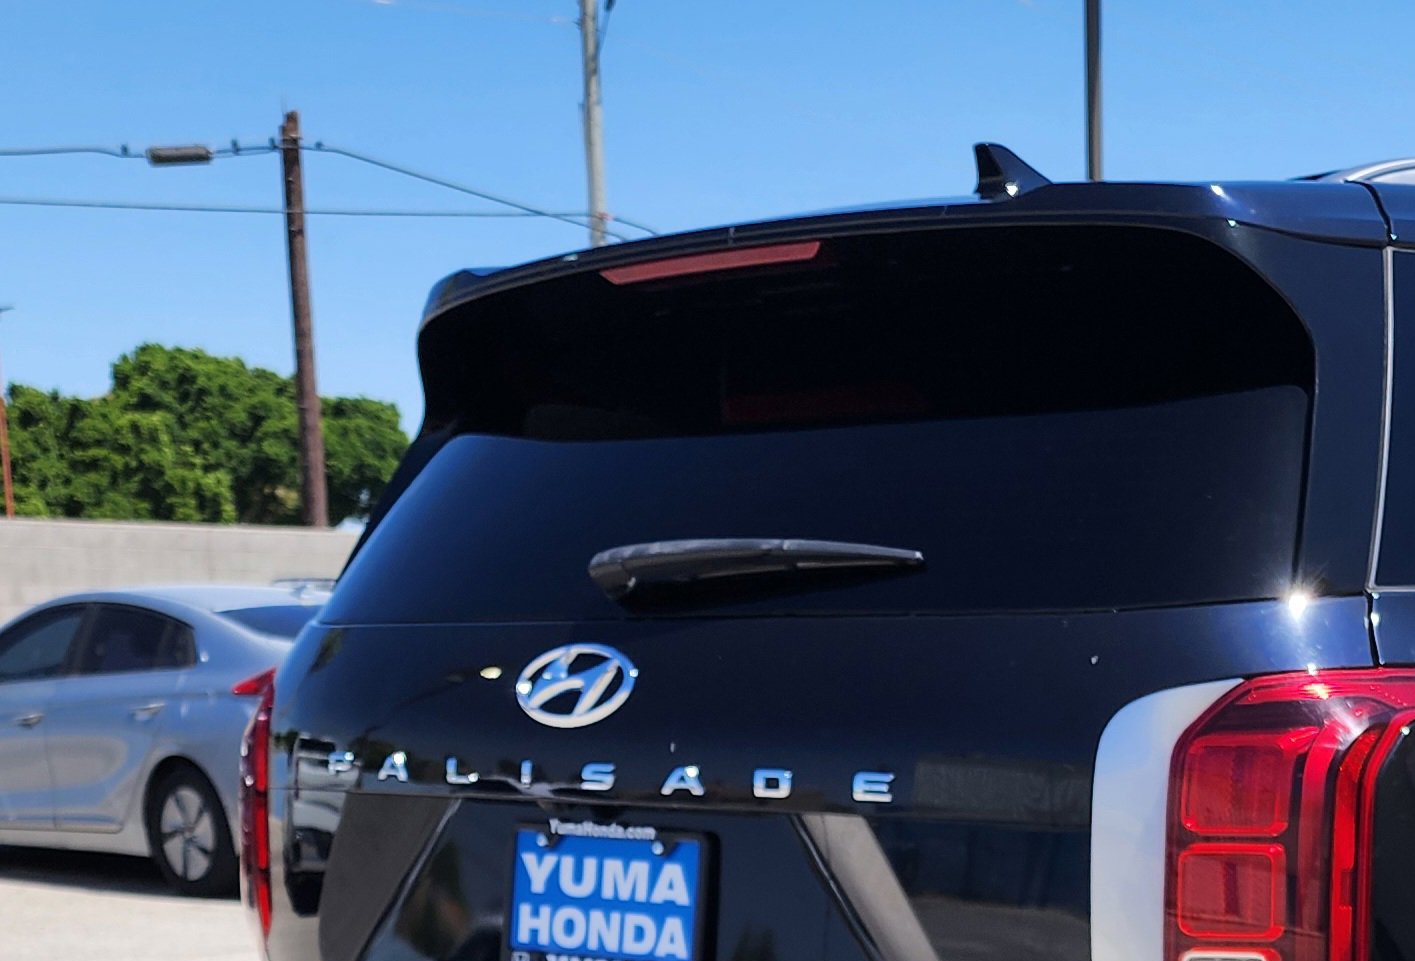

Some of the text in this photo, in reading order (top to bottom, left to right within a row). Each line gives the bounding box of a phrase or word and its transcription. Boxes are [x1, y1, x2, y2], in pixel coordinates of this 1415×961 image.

[328, 750, 896, 803] PALISADE
[520, 852, 691, 906] YUMA
[516, 902, 689, 960] HONDA
